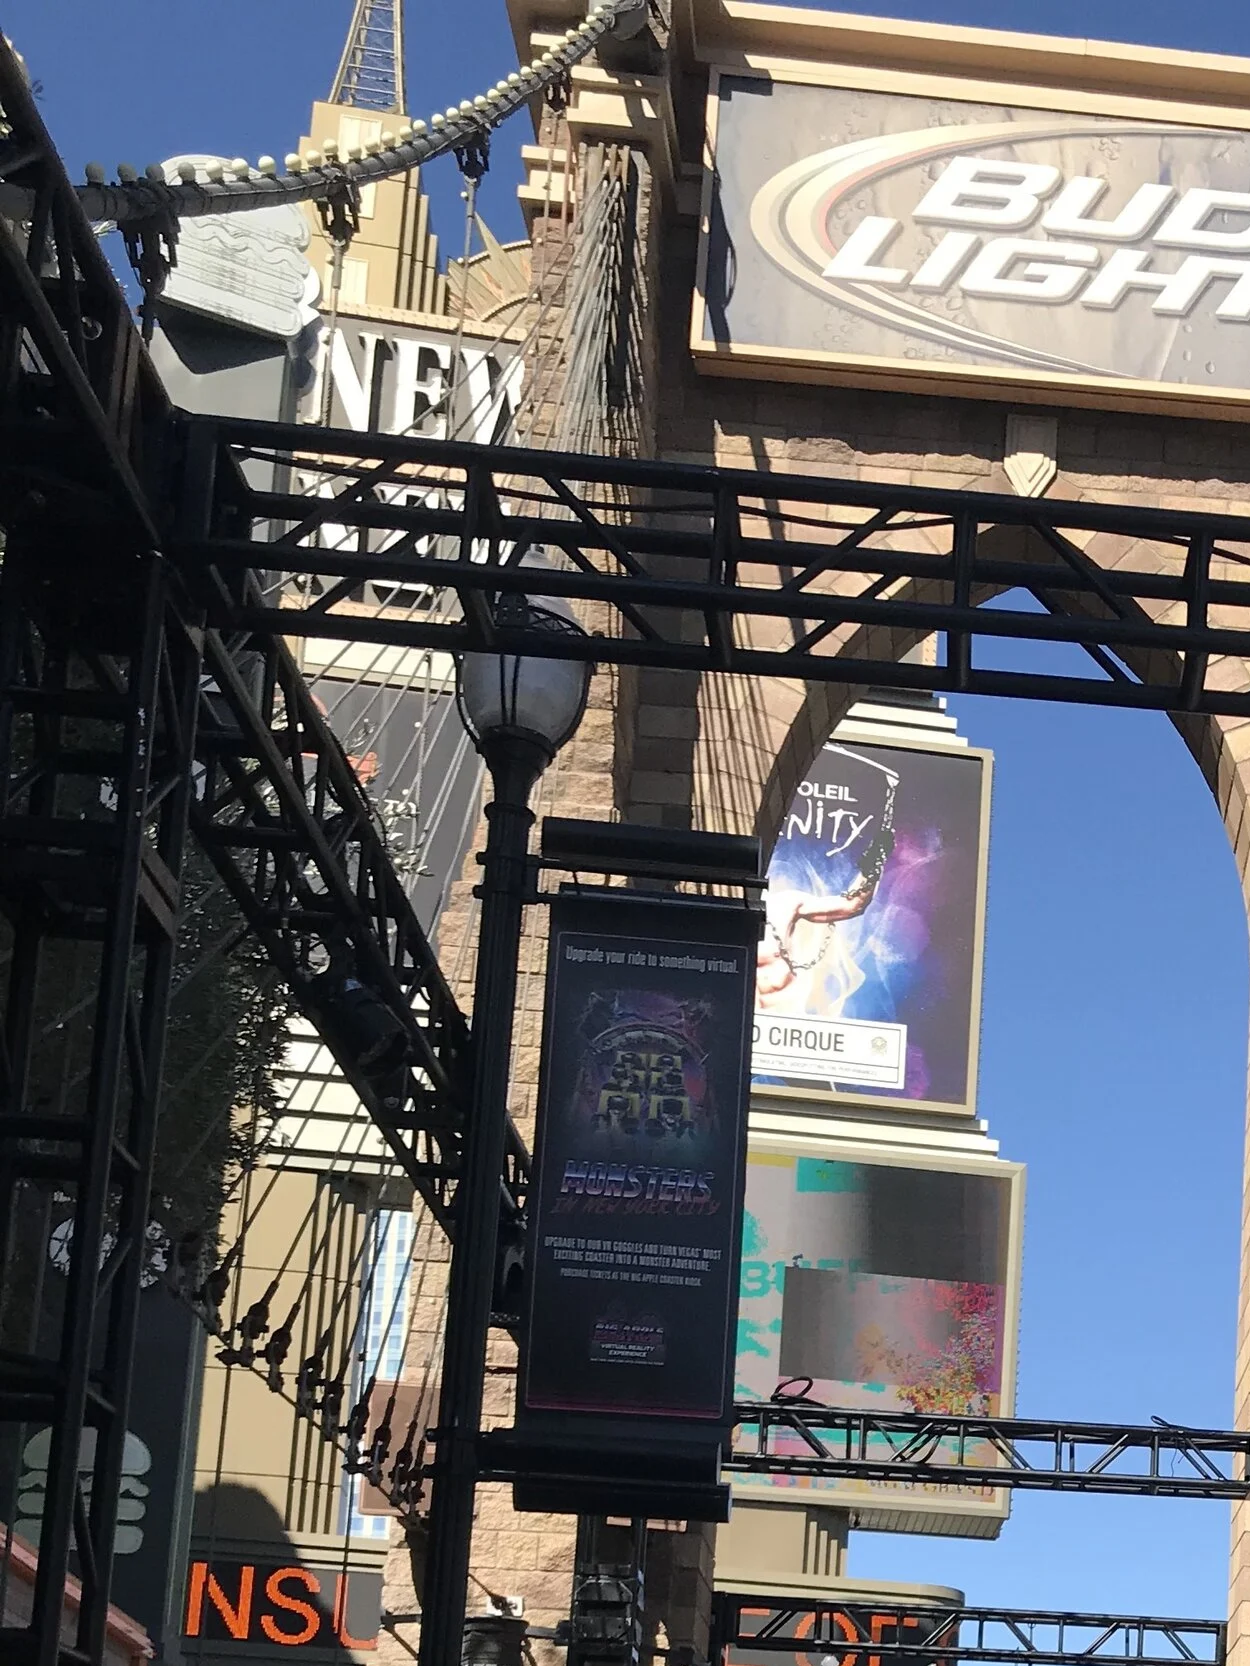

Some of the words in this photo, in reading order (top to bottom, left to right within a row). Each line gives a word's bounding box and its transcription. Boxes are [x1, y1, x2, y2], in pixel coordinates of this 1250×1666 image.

[303, 327, 526, 446] NEW
[797, 781, 858, 802] OLEIL
[566, 946, 604, 962] Upgrade
[605, 951, 625, 965] your
[628, 950, 646, 965] ride
[647, 954, 658, 966] to
[659, 956, 705, 972] something
[707, 958, 739, 973] virtual.
[769, 1027, 845, 1052] CIRQUE
[560, 1159, 716, 1203] MONSTERS
[544, 1236, 576, 1248] UPGRADE
[577, 1238, 586, 1249] TO
[613, 1241, 643, 1253] GOGGLES
[644, 1242, 658, 1254] AND
[659, 1244, 677, 1256] TURN
[703, 1248, 722, 1260] MOST
[553, 1249, 583, 1261] EXCITING
[585, 1251, 614, 1263] COASTER
[615, 1253, 631, 1265] INTO
[632, 1255, 638, 1265] A
[639, 1256, 670, 1268] MONSTER
